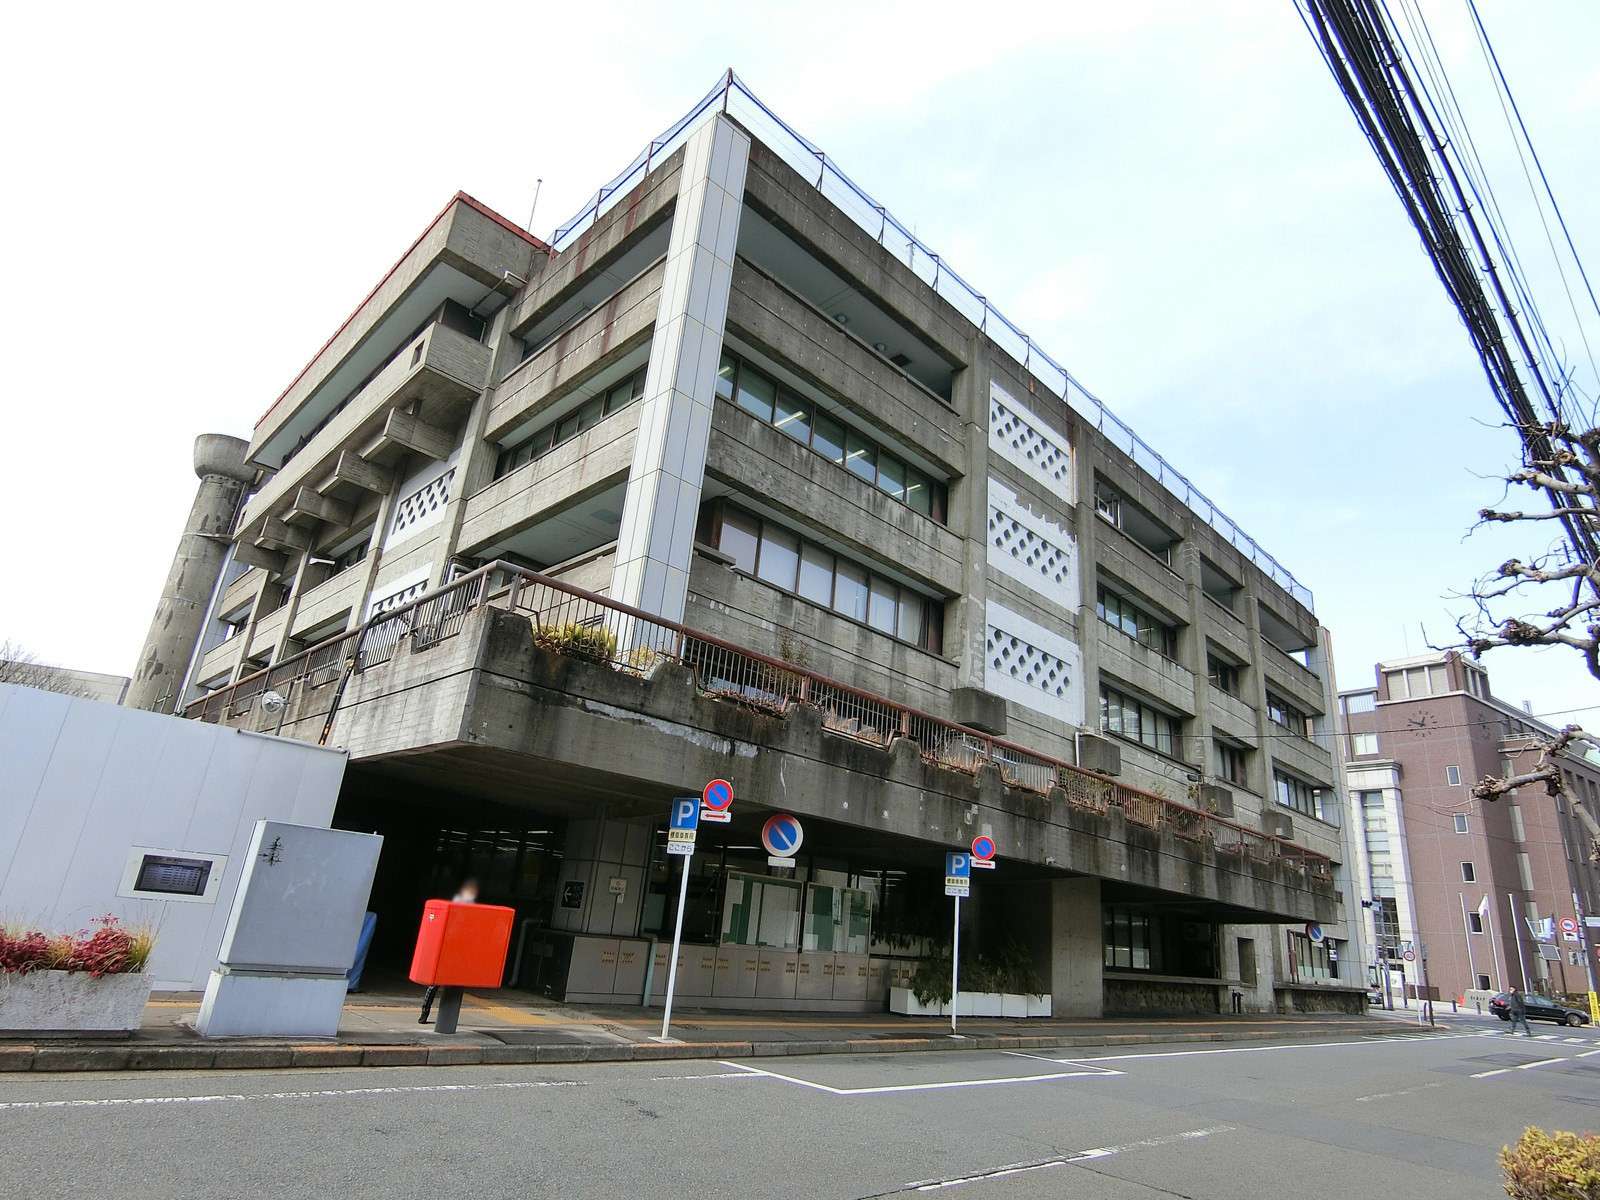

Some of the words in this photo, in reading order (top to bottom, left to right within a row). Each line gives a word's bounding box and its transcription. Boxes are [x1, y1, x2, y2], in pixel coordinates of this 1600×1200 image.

[677, 801, 694, 826] P
[669, 843, 692, 852] ここから
[952, 855, 965, 875] P
